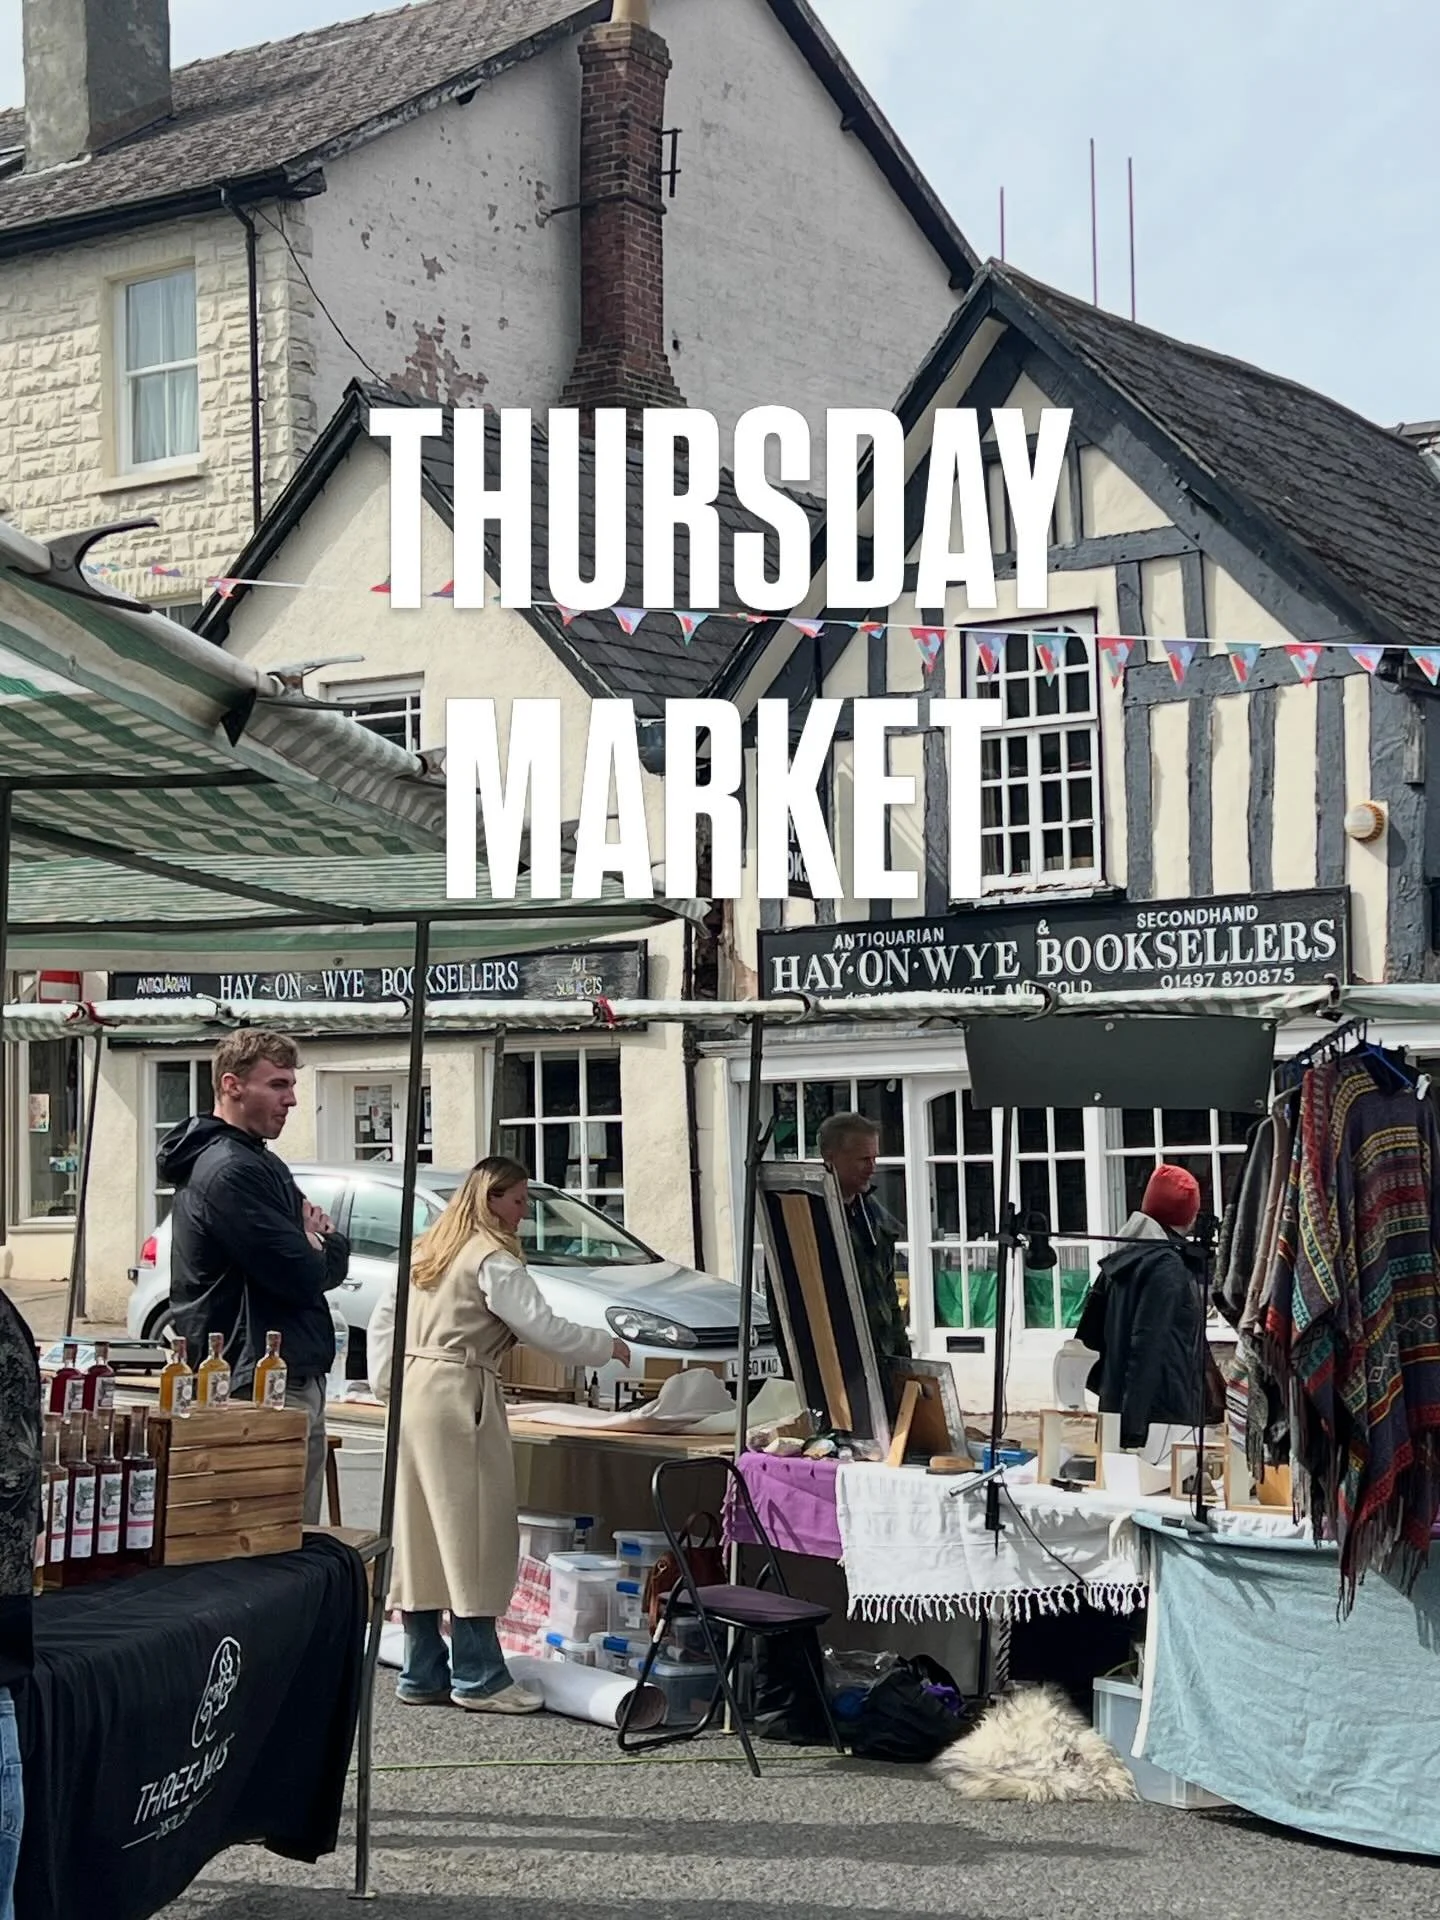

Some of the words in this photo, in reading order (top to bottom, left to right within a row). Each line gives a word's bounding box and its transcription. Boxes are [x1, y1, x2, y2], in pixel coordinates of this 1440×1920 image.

[834, 927, 945, 950] ANTIQUARIAN
[1036, 919, 1049, 935] &
[1137, 904, 1259, 929] SECONDHAND
[1036, 918, 1337, 977] BOOKSELLERS
[219, 974, 258, 1000] HAY
[275, 972, 301, 1000] ON
[321, 969, 365, 998] WYE
[1160, 972, 1215, 989] 01497
[1221, 966, 1296, 986] 820875
